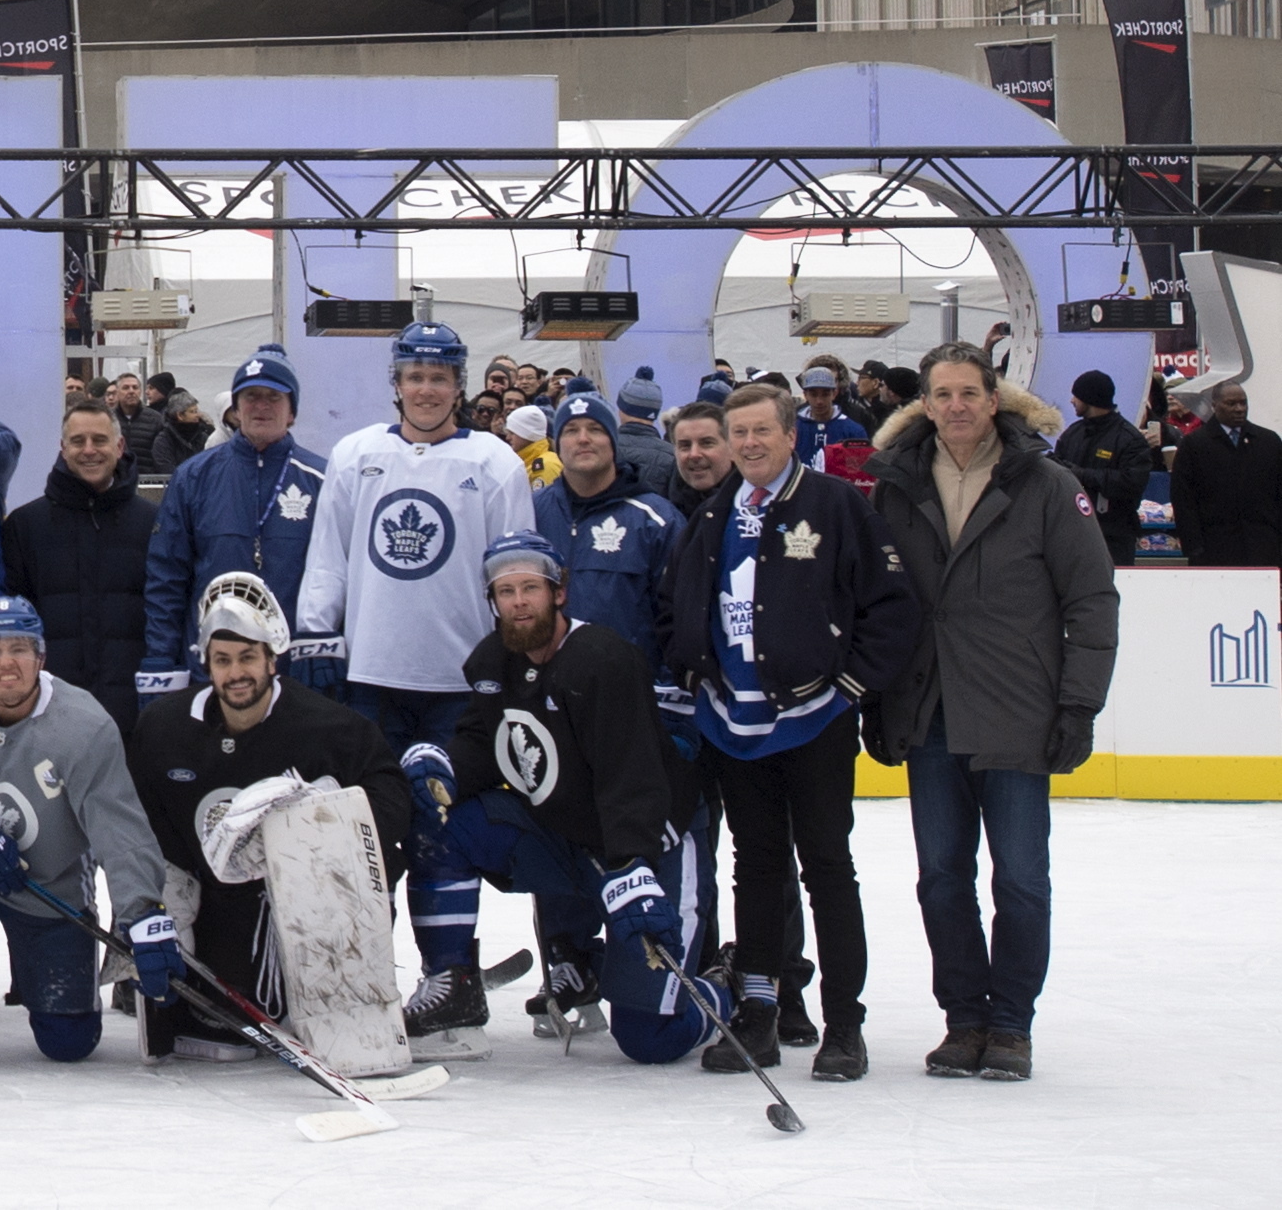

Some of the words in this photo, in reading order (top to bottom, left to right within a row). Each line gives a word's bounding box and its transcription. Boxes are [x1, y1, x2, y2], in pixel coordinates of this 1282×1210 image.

[392, 530, 427, 542] TORONTO
[395, 538, 420, 547] MAPLE
[394, 546, 420, 554] LEAFS
[723, 601, 753, 614] TORO
[730, 613, 753, 625] MAP
[733, 626, 753, 637] LEA
